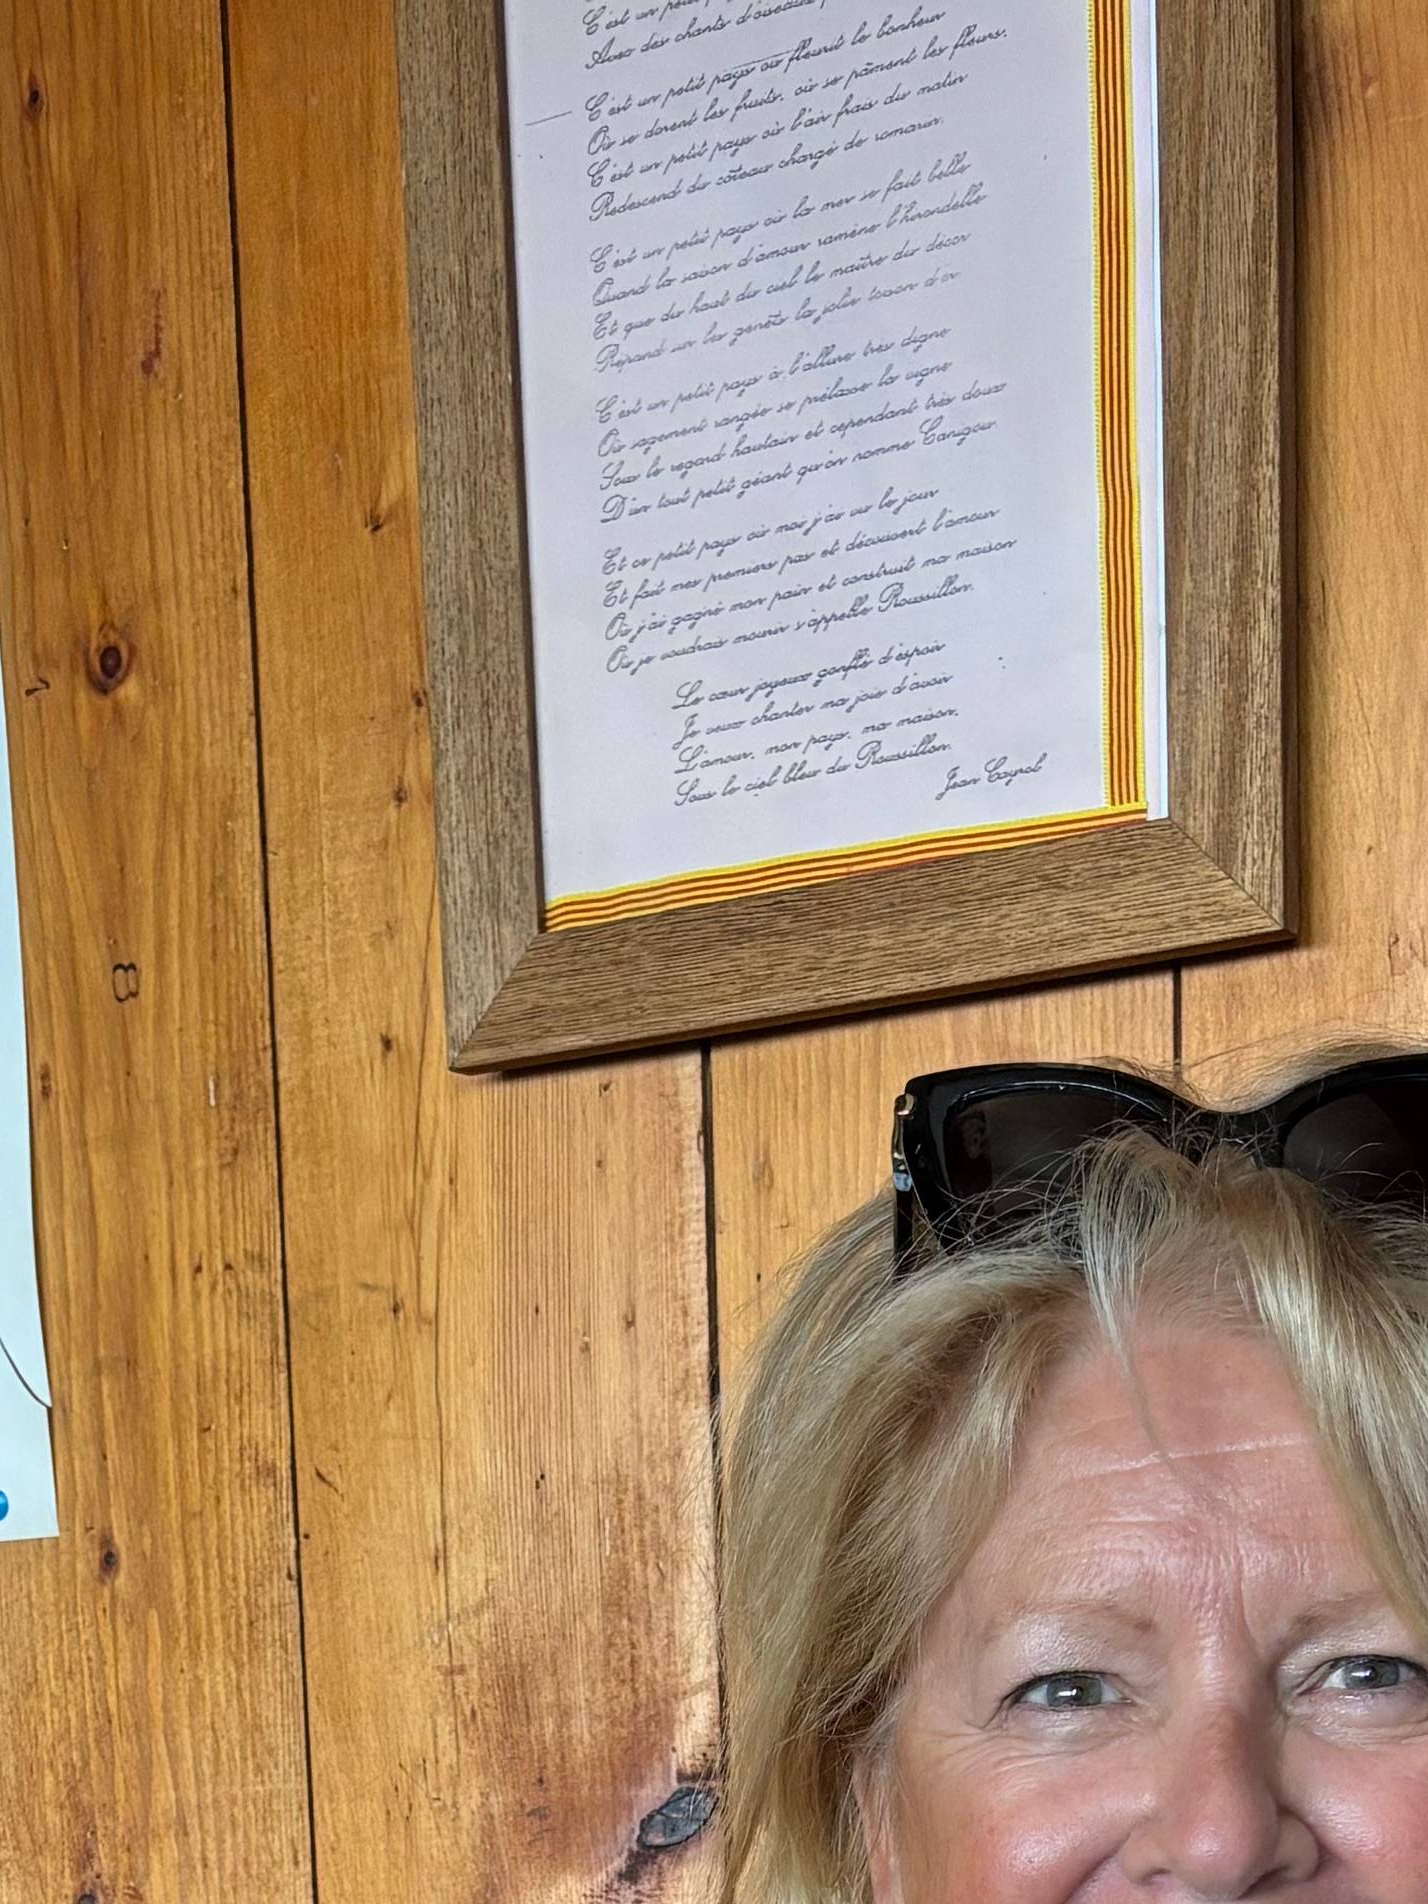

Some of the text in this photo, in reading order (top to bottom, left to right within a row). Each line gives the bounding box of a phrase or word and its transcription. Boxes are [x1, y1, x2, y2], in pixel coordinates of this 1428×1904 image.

[585, 5, 946, 122] C'est un petit pays où fleurit le bonheur
[587, 125, 616, 156] Où
[619, 134, 640, 147] se
[644, 109, 698, 139] dorent
[703, 97, 730, 122] les
[794, 78, 819, 96] où
[821, 75, 844, 89] se
[922, 35, 949, 60] les
[948, 24, 1007, 61] fleurs.
[589, 178, 683, 222] Redescend
[686, 173, 711, 194] du
[778, 140, 839, 170] chargé
[843, 129, 869, 152] de
[599, 379, 1007, 491] Sous le regard hautain et cependant très doux
[600, 494, 652, 524] D'un
[657, 487, 690, 509] tout
[690, 476, 736, 509] petit
[736, 462, 793, 499] géant
[796, 449, 848, 485] qu'on
[852, 440, 916, 463] nomme
[602, 486, 939, 575] Et ce petit pays où moi j'ai vu le jour
[605, 539, 1018, 644] Où j'ai gagné mon pain et construit ma maison
[606, 645, 635, 673] Où
[629, 656, 657, 676] je
[660, 635, 729, 661] voudrais
[732, 622, 790, 644] mourir
[793, 593, 873, 634] s'appelle
[671, 679, 705, 710] Le
[744, 672, 813, 702] joyeux
[812, 647, 874, 688] gonflé
[878, 640, 946, 667] d'espoir
[671, 672, 954, 751] Je veux chanter ma joie d'avoir
[674, 778, 717, 807] Sous
[721, 774, 741, 797] le
[744, 765, 782, 794] ciel
[782, 759, 822, 784] bleu
[825, 756, 851, 775] du
[764, 742, 802, 755] mon
[861, 722, 892, 734] ma
